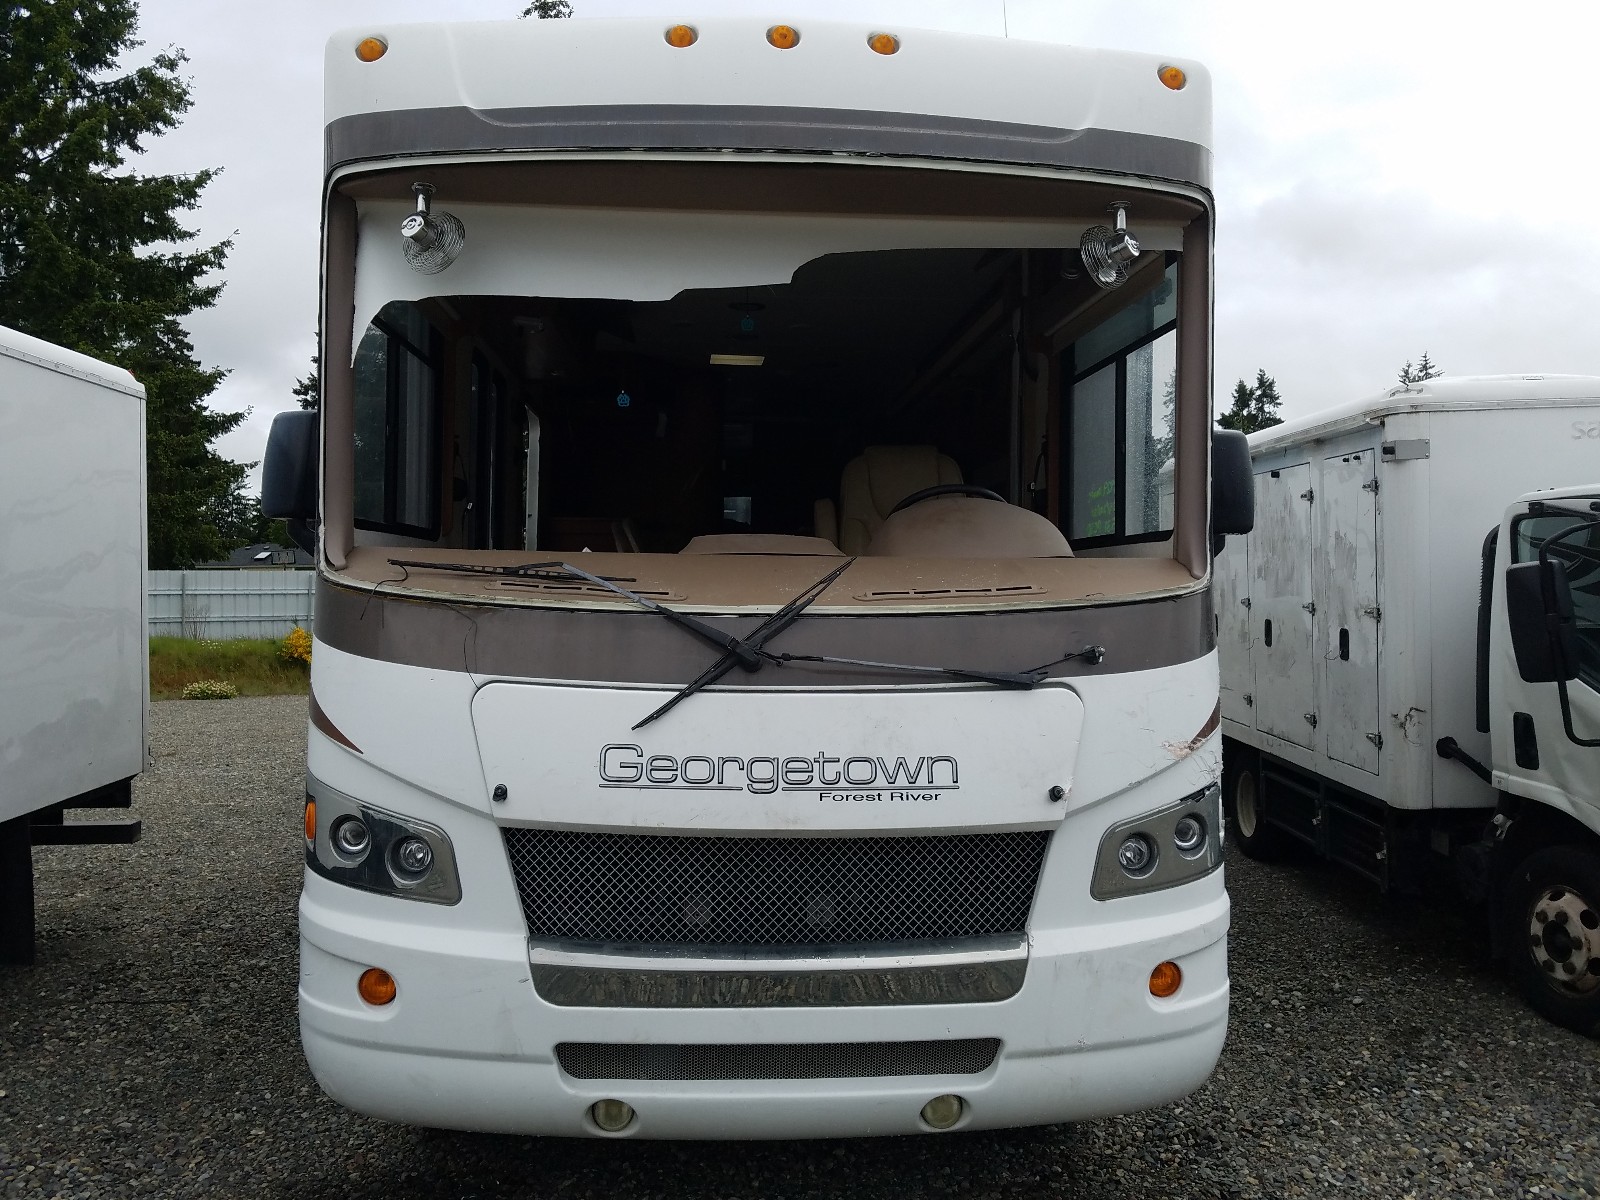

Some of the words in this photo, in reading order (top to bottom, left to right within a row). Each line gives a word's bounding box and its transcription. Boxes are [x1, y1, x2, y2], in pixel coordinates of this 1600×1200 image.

[599, 743, 959, 794] Georgetown
[819, 791, 883, 802] Forest
[890, 791, 942, 802] River
